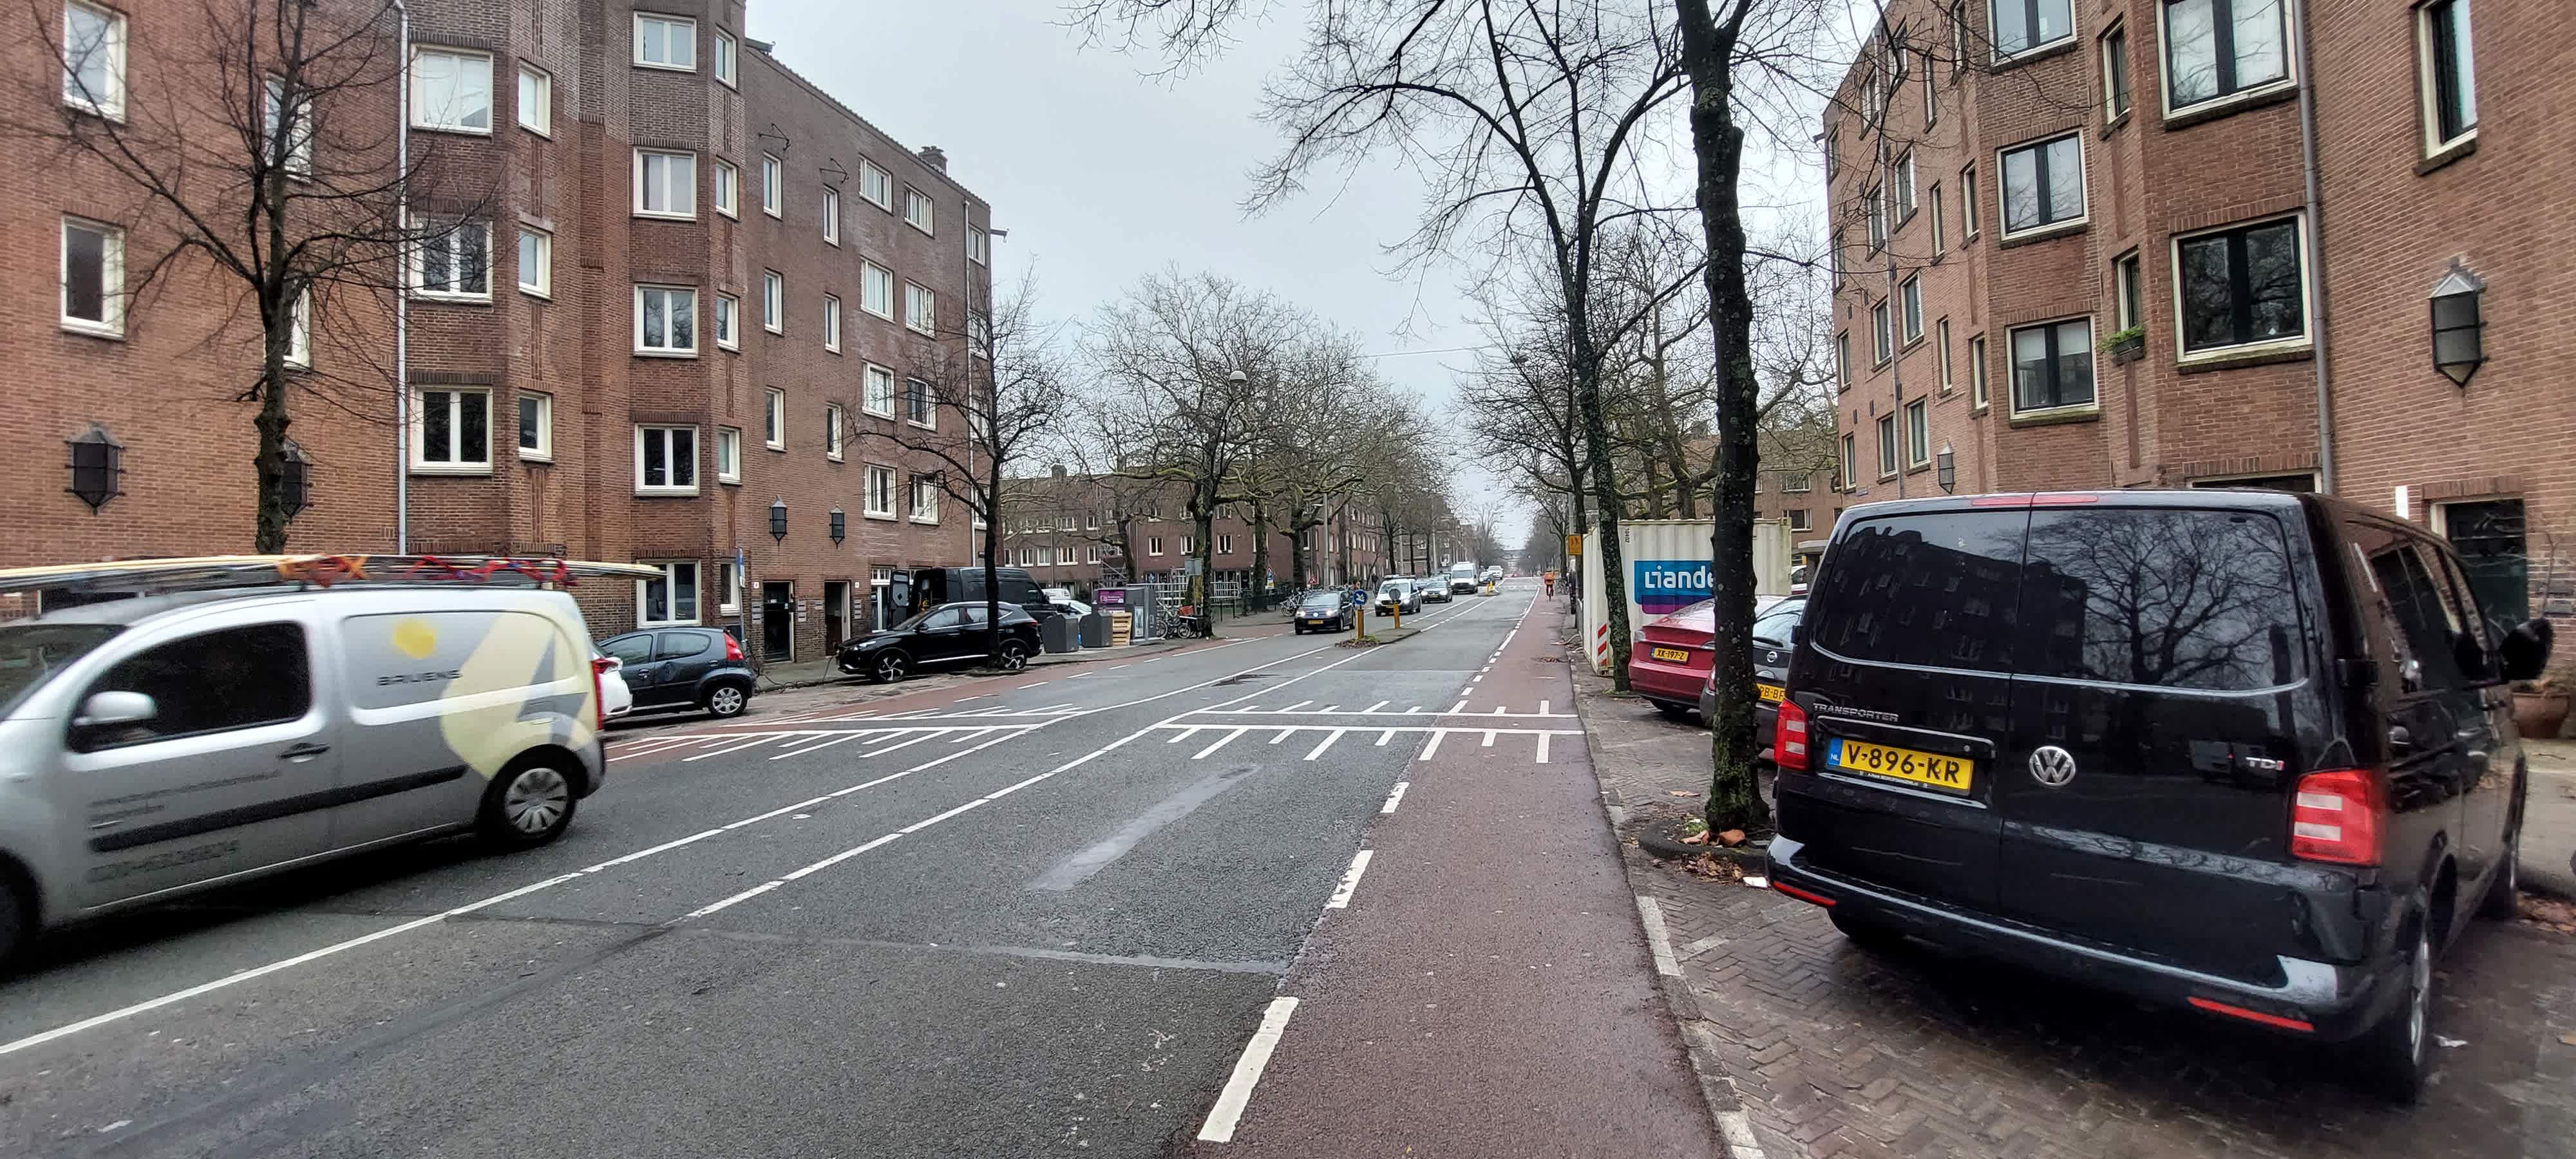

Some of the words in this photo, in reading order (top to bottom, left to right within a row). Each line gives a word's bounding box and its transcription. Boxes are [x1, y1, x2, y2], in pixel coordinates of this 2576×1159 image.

[1813, 702, 1899, 722] TRANSPORTER
[1830, 753, 1839, 761] NL
[1847, 744, 1960, 784] V-896-KR
[2246, 757, 2284, 771] TDI
